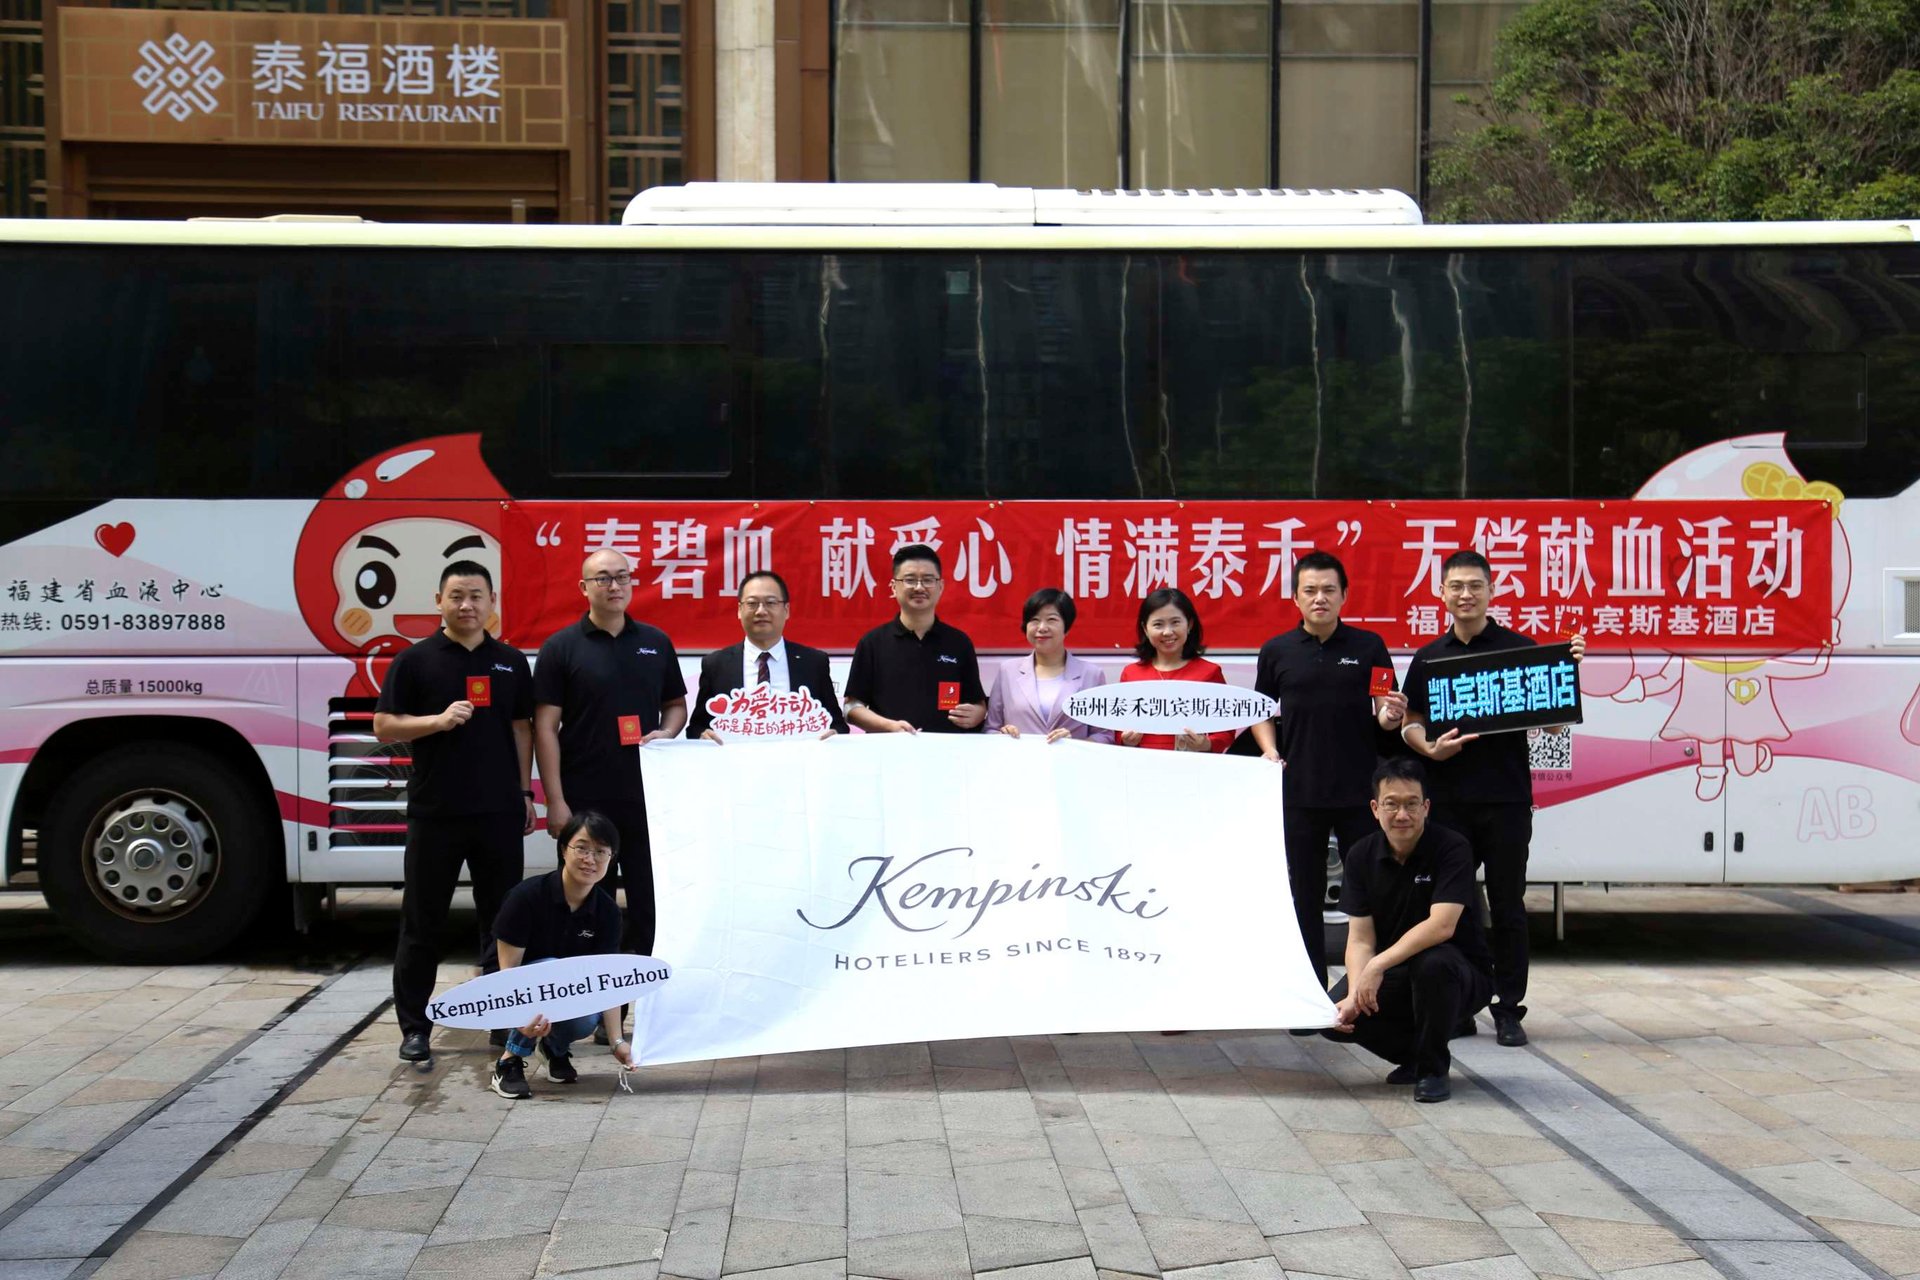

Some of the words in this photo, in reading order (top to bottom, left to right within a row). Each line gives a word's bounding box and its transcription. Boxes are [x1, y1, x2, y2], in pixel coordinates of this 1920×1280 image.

[252, 40, 501, 97] 泰福酒楼
[252, 102, 325, 121] TAIFU
[338, 103, 502, 123] RESTAURANT
[7, 577, 224, 603] 福建省血液中心
[85, 679, 133, 695] 总质量
[138, 680, 203, 695] 15000kg
[1427, 660, 1576, 722] 凯宾斯基酒店
[713, 711, 830, 736] 你是真正的种子选手
[1068, 697, 1274, 718] 福州泰禾凯宾斯基酒店
[1796, 785, 1877, 843] AB
[796, 847, 1169, 940] Kempinski
[835, 949, 991, 971] HOTELIERS
[1006, 937, 1091, 957] SINCE
[1103, 945, 1162, 965] 1897
[429, 987, 533, 1020] Kempinski
[538, 976, 593, 1002] Hotel
[597, 967, 670, 992] Fuzhou
